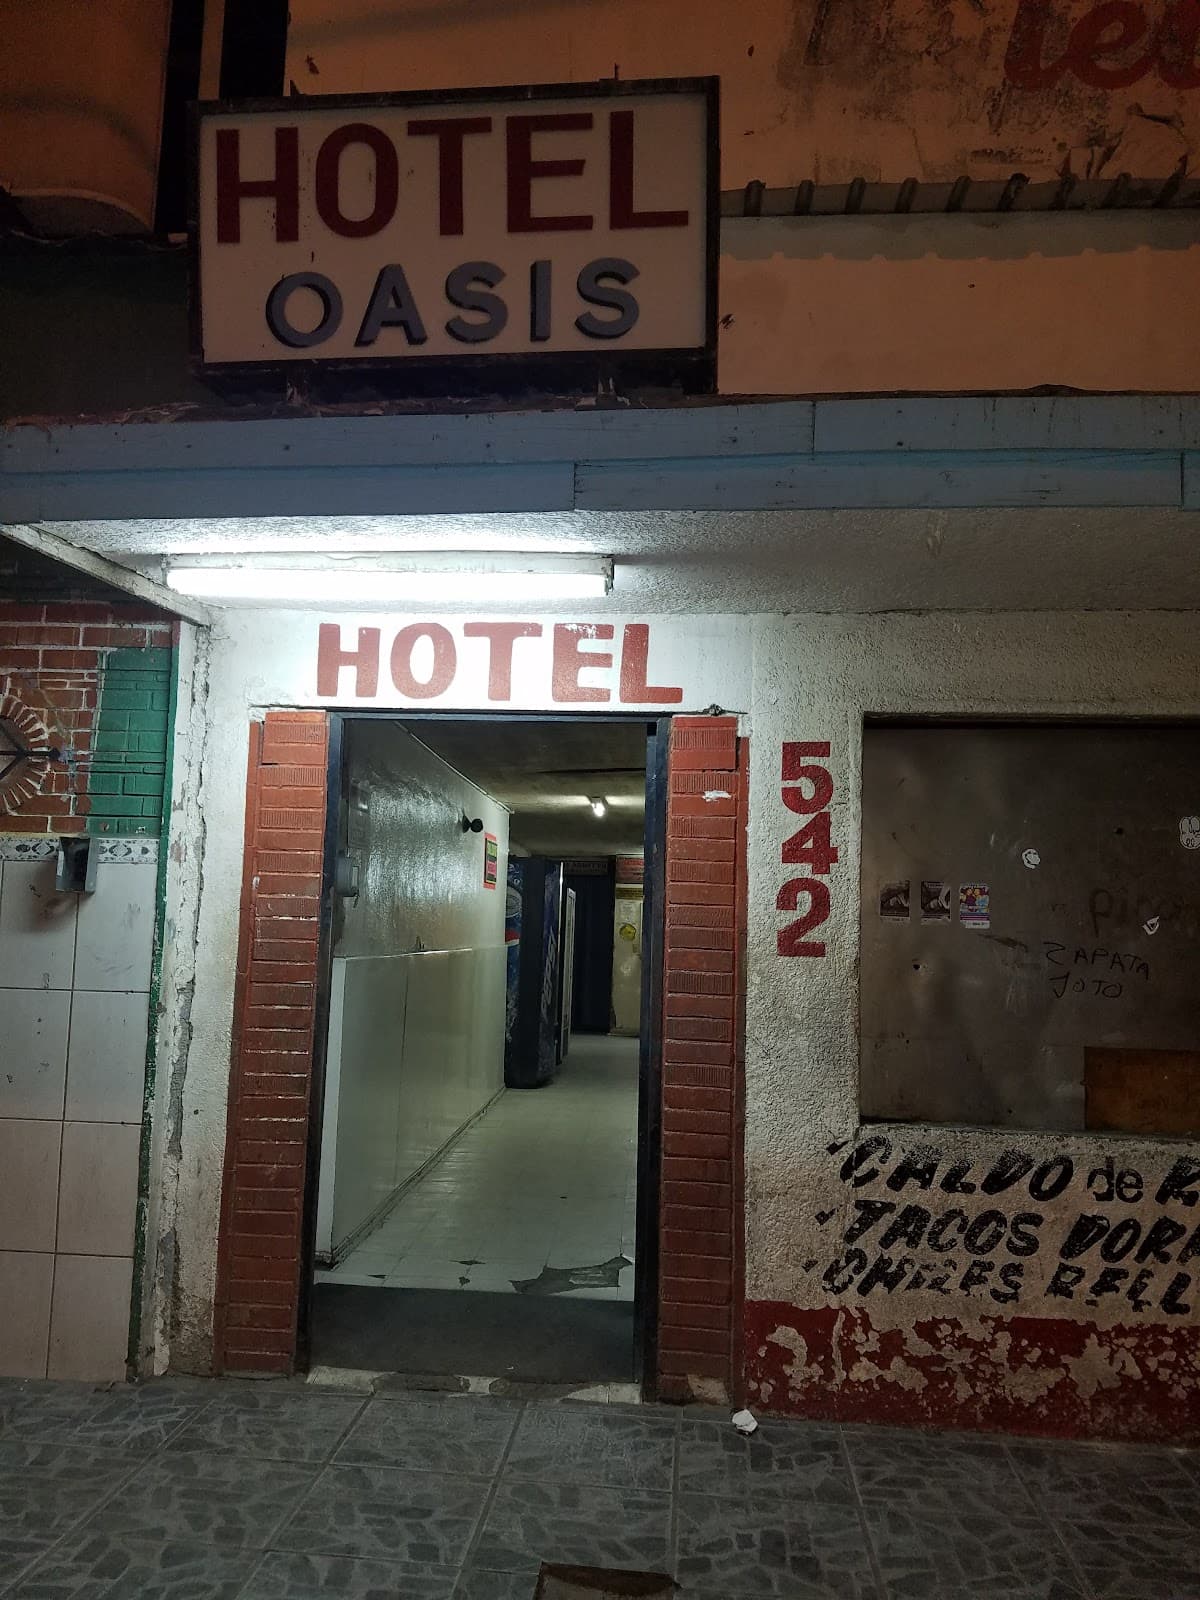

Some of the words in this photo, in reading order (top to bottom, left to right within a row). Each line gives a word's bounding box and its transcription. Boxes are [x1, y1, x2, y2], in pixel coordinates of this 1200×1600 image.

[216, 110, 689, 243] HOTEL
[265, 258, 640, 348] OASIS
[317, 622, 683, 704] HOTEL
[776, 741, 838, 959] 542
[1044, 942, 1150, 980] ZAPATA
[1049, 972, 1123, 998] JOTO
[840, 1135, 1075, 1202] CALDO
[1087, 1155, 1144, 1204] de
[844, 1199, 1044, 1257] TACOS
